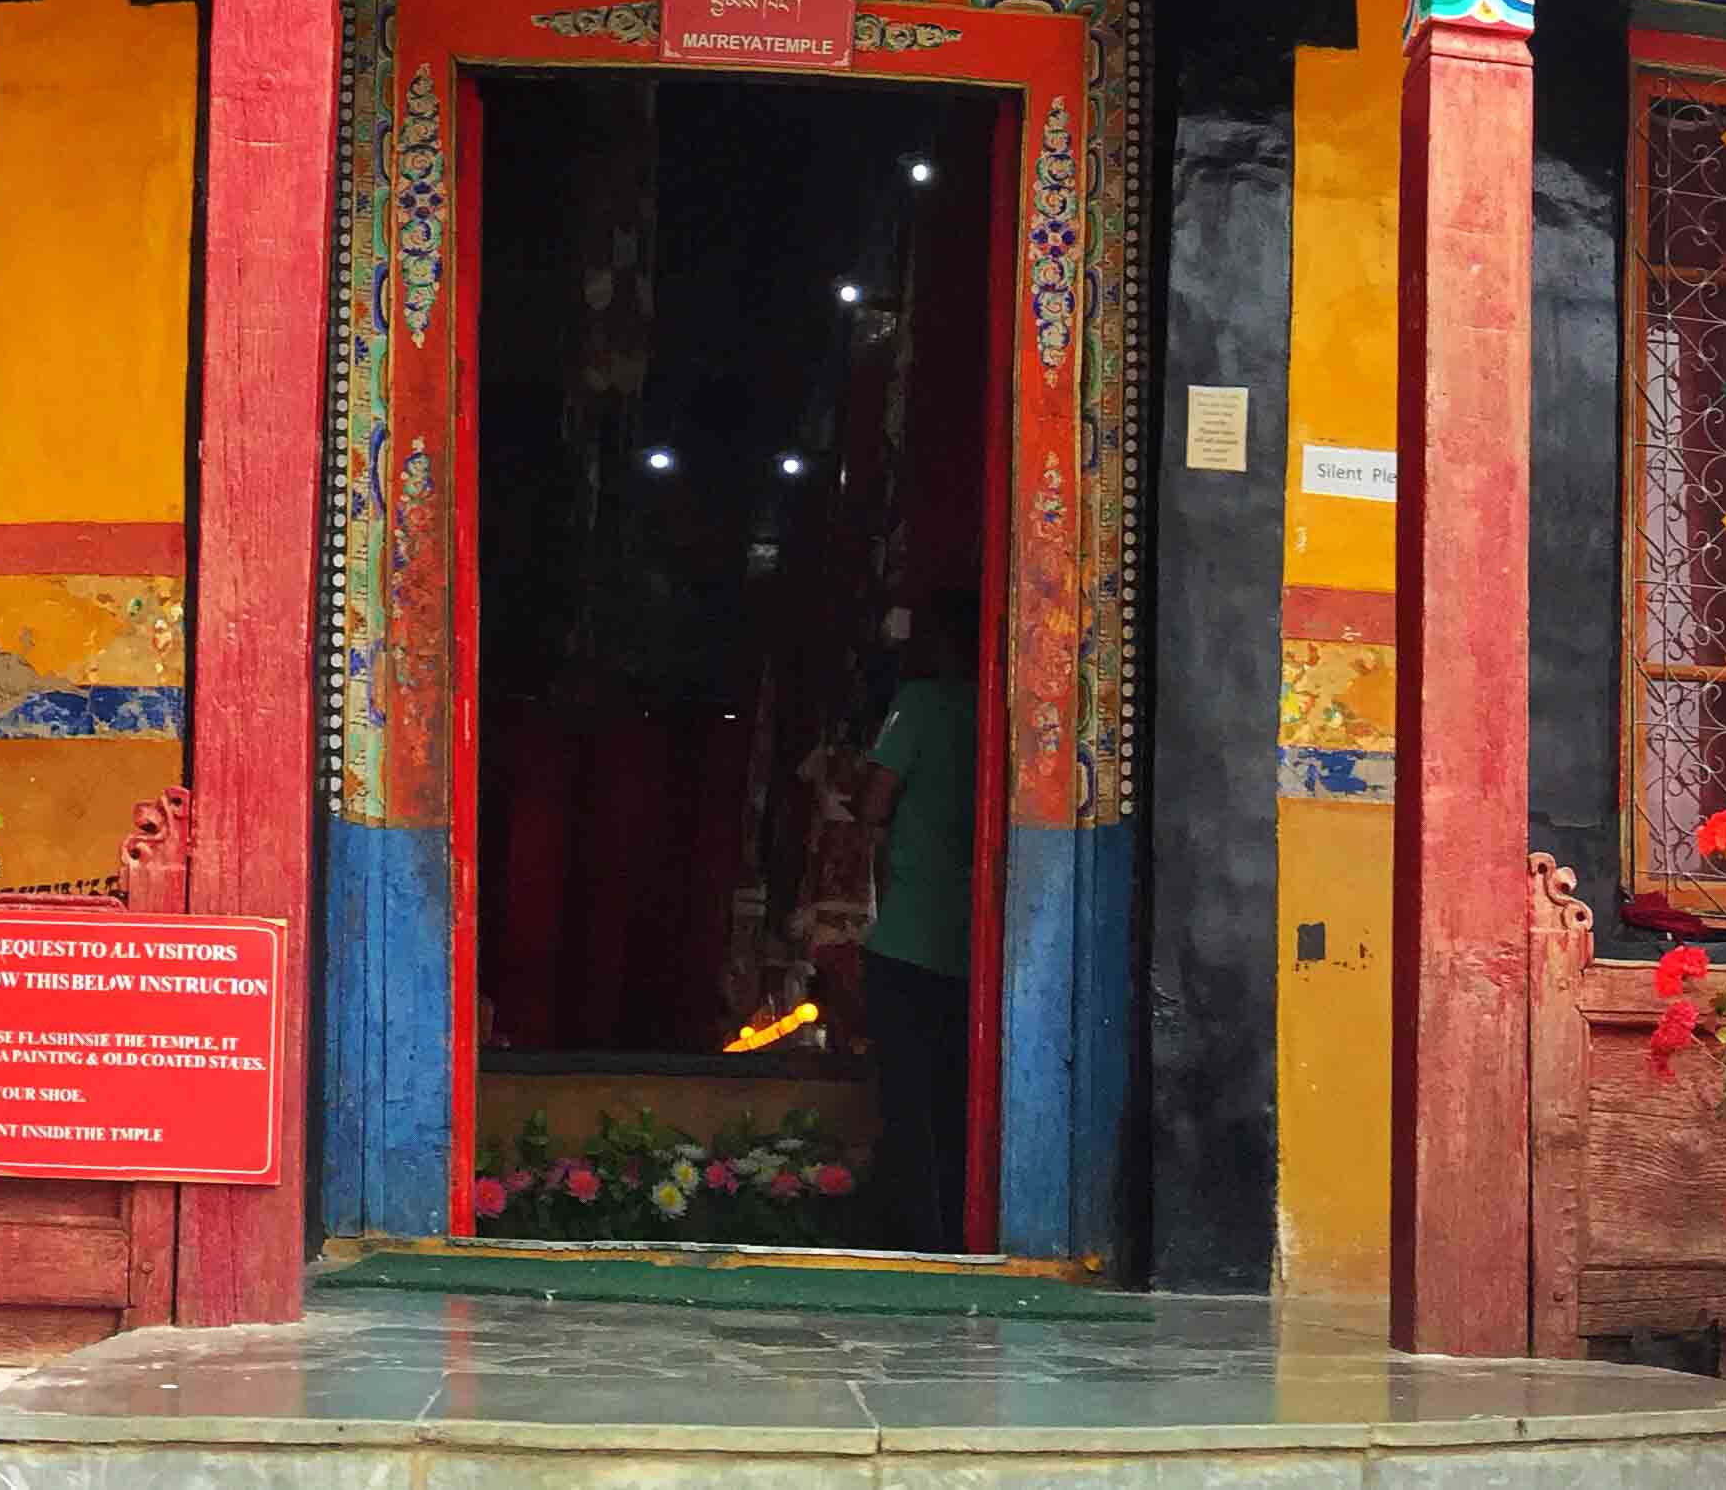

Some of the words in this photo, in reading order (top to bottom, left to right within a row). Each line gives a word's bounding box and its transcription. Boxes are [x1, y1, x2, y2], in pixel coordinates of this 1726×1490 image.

[1317, 463, 1362, 481] Silent
[1372, 468, 1397, 484] Ple
[79, 941, 107, 958] TO
[143, 942, 237, 961] VISITORS
[25, 972, 68, 989] THIS
[115, 1034, 146, 1047] THE
[86, 1052, 98, 1066] &
[140, 1054, 206, 1069] COATED
